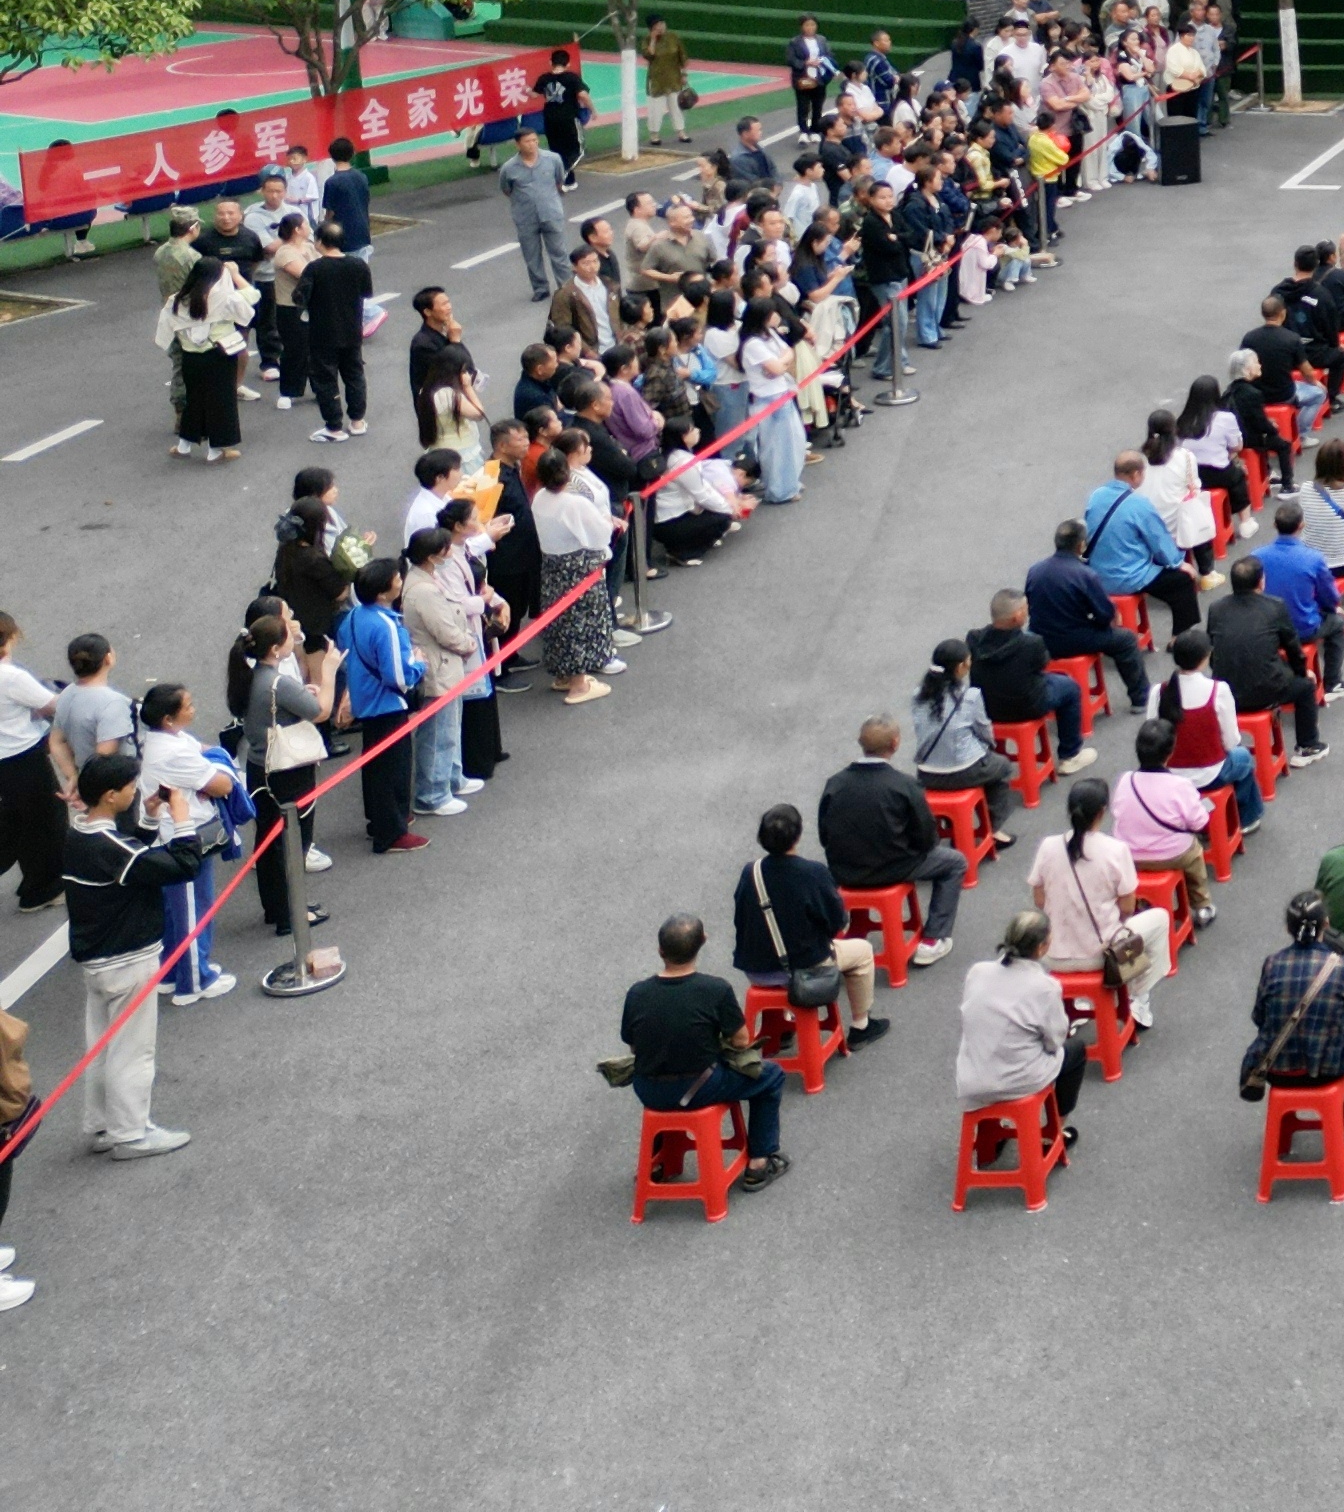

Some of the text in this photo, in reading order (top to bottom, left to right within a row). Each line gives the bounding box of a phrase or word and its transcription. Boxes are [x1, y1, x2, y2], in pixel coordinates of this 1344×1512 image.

[83, 68, 530, 186] 一人参军 全家光荣
